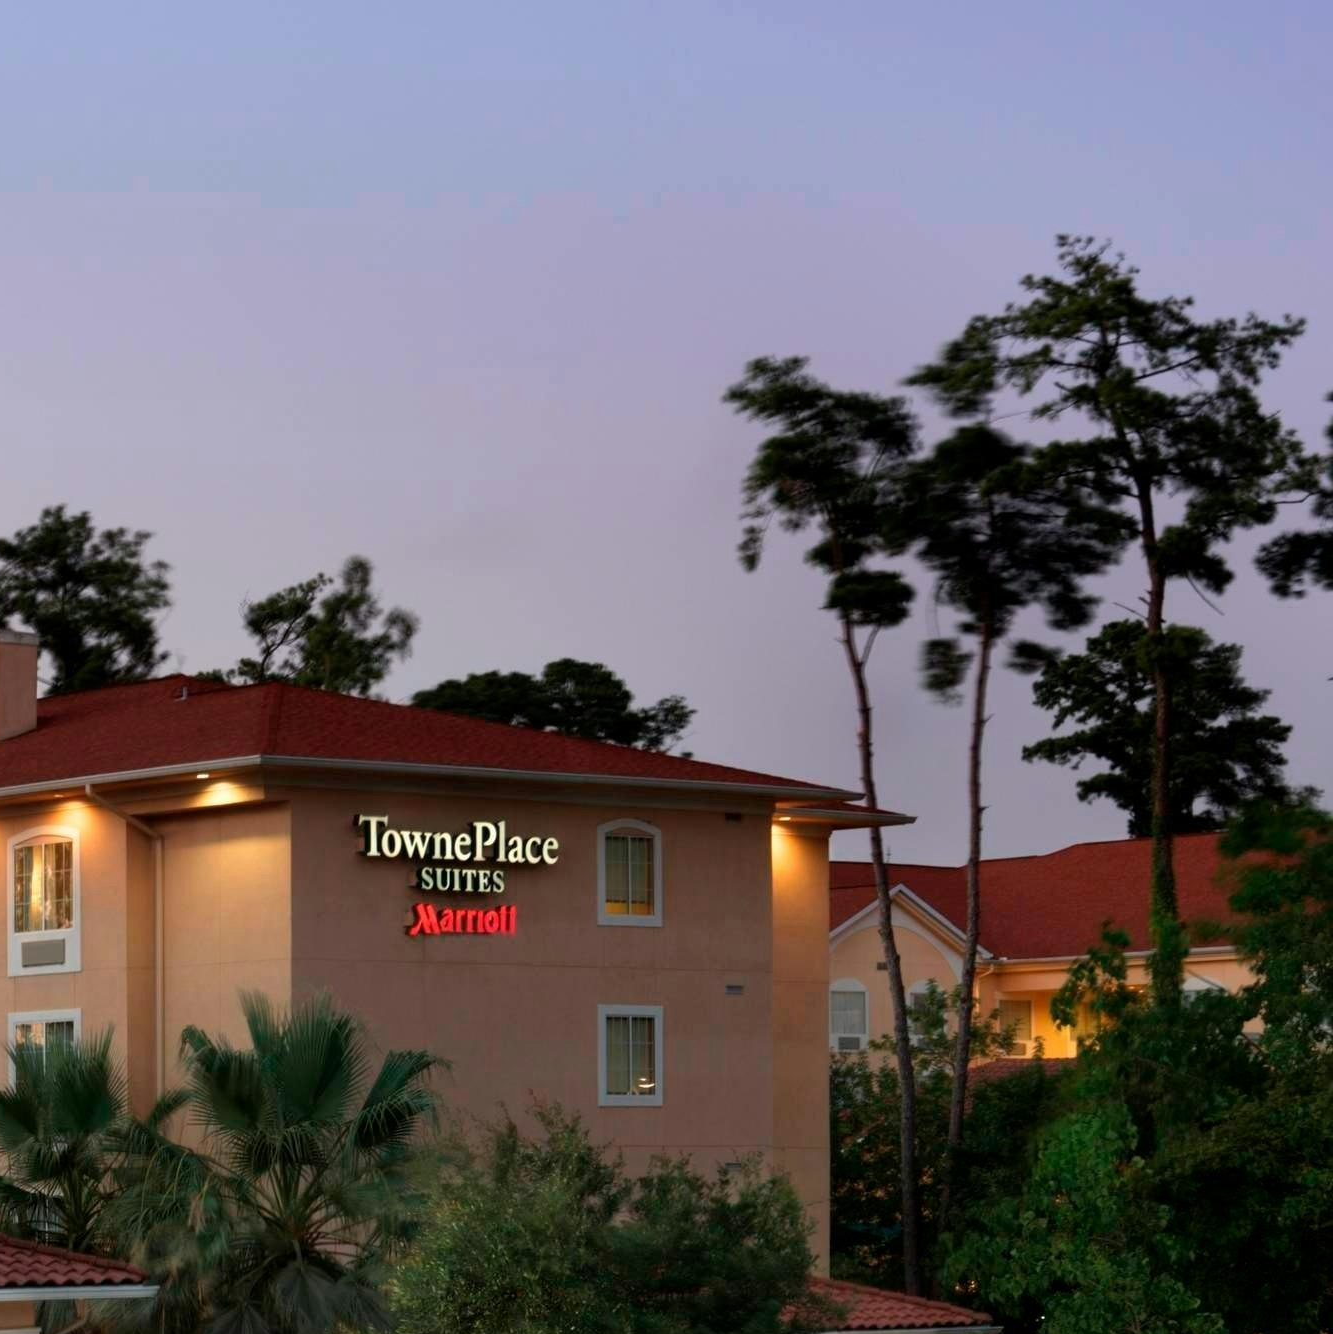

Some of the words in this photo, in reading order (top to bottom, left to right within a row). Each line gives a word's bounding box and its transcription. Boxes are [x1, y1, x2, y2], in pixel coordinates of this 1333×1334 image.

[358, 814, 559, 865] TownePlace
[420, 866, 505, 893] SUITES
[408, 902, 517, 937] Marriott
